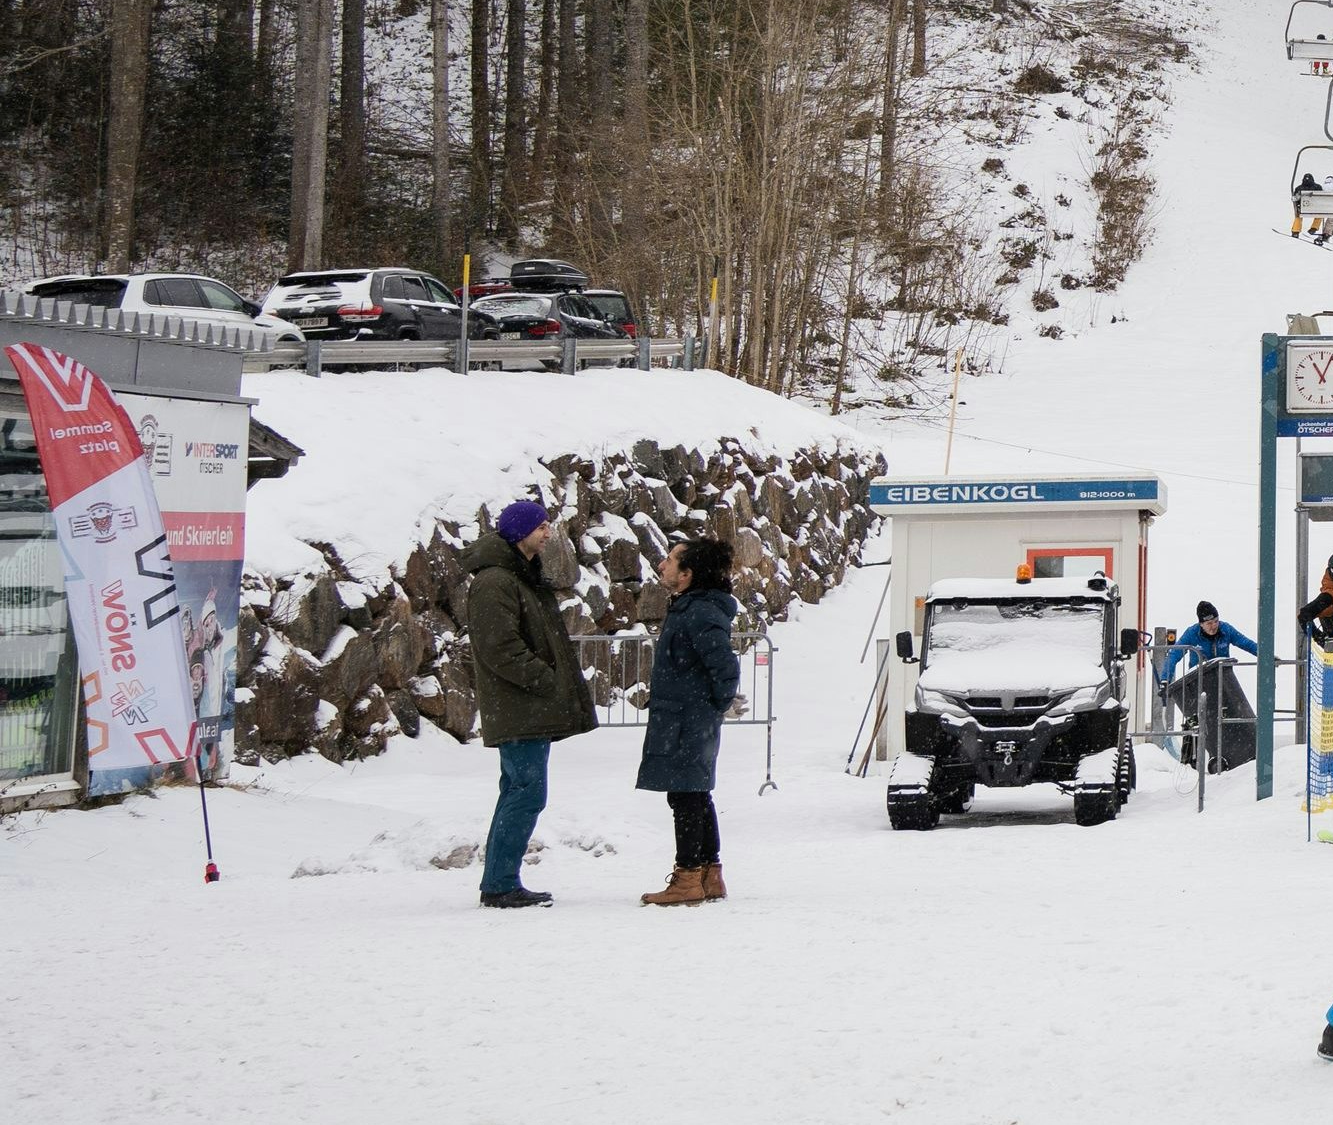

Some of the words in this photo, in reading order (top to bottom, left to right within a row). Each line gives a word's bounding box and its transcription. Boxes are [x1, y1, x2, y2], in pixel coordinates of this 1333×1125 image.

[193, 442, 238, 459] INTERSPORT
[887, 485, 1045, 502] EIBENKOGL
[186, 526, 233, 546] Skiverleih
